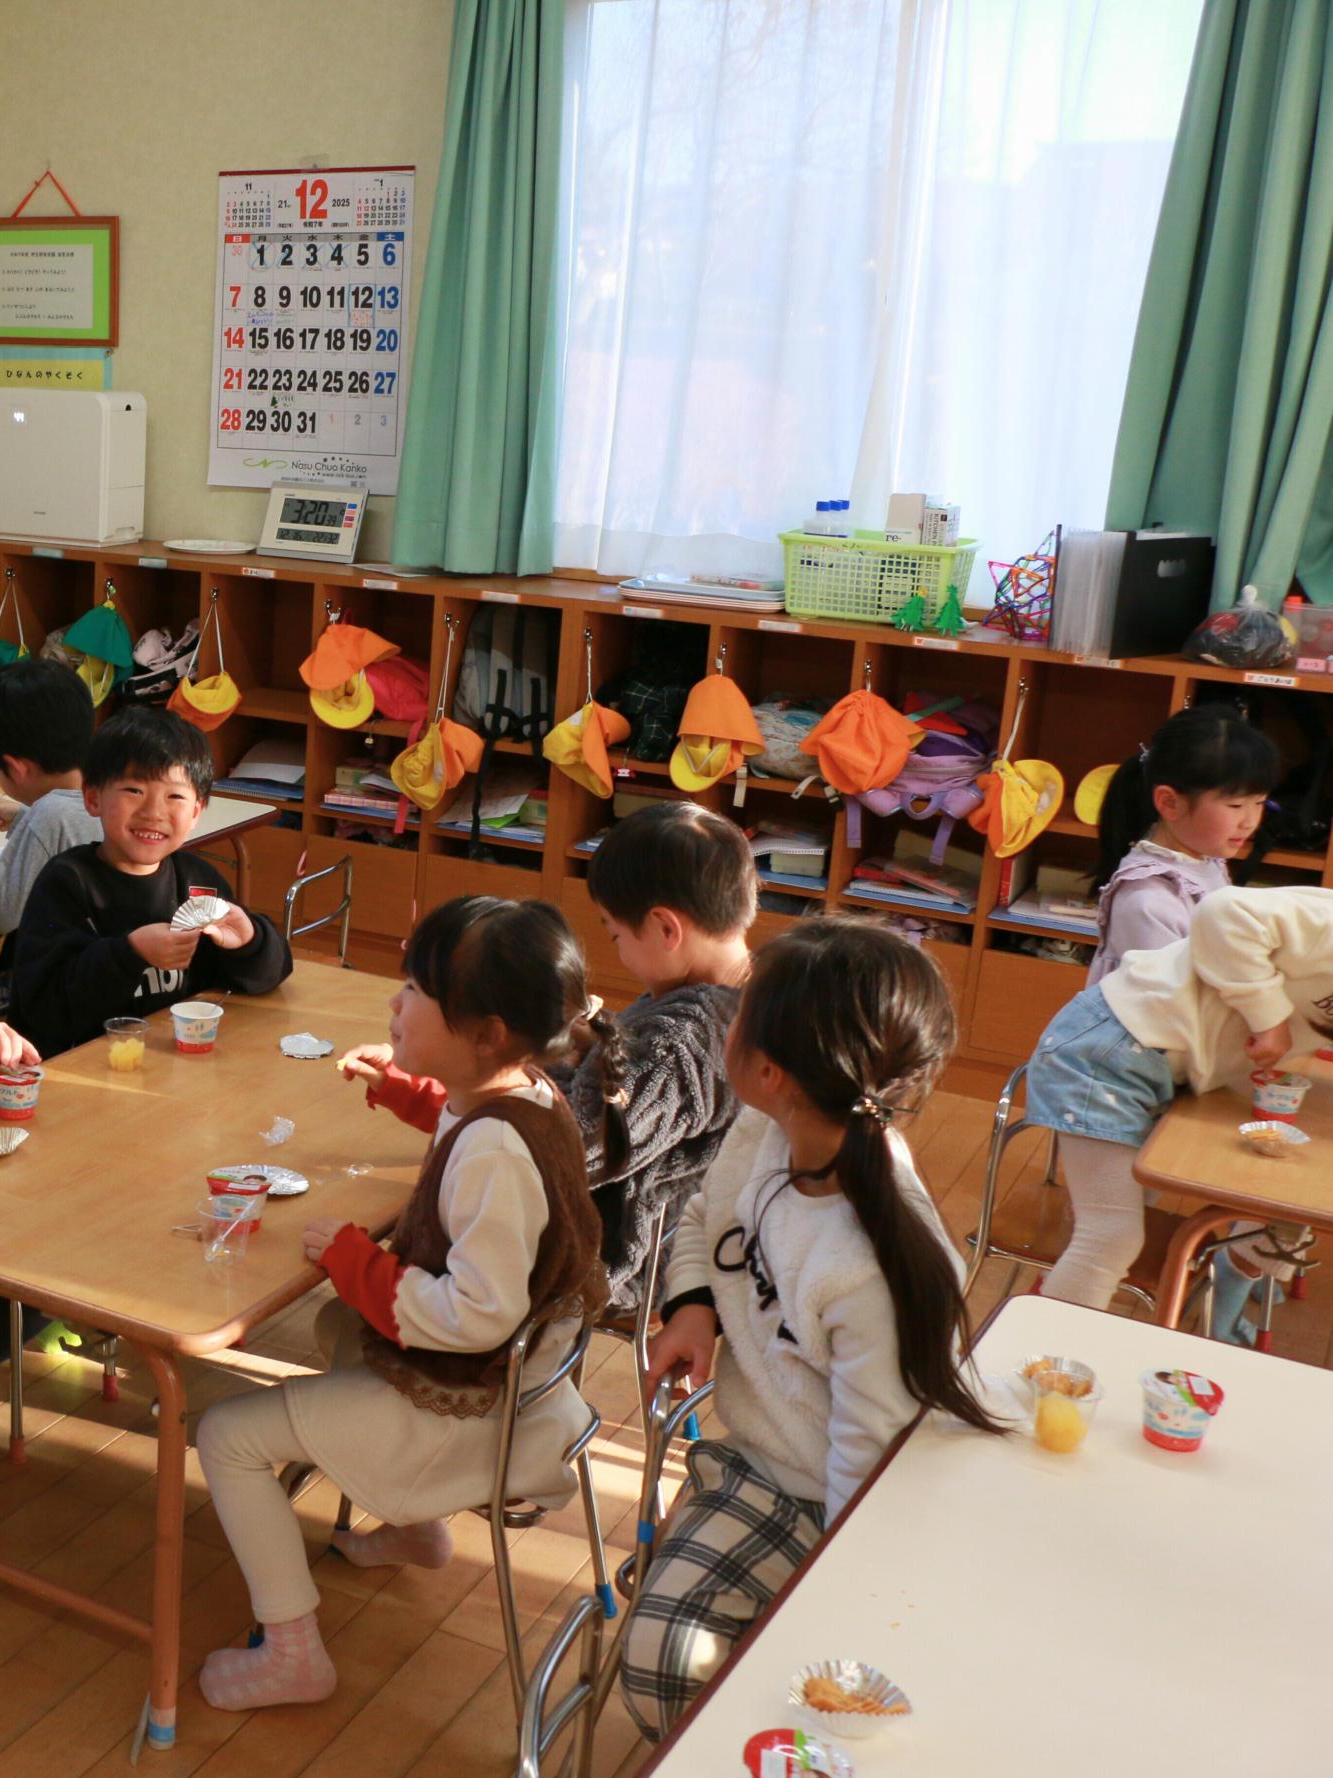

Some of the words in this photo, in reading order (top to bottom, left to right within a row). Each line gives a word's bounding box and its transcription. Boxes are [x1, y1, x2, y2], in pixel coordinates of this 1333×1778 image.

[245, 182, 252, 190] 11
[278, 200, 286, 208] 21
[295, 178, 328, 219] 12
[332, 198, 350, 207] 2025
[231, 245, 242, 256] 30
[257, 245, 264, 266] 1
[281, 244, 293, 266] 2
[306, 244, 318, 266] 3
[331, 244, 343, 266] 4
[356, 244, 368, 266] 5
[383, 243, 396, 266] 6
[230, 286, 241, 308] 7
[254, 286, 266, 308] 8
[279, 286, 291, 308] 9
[300, 286, 321, 308] 10
[327, 286, 345, 308] 11
[352, 286, 373, 308] 12
[378, 286, 399, 309] 13
[224, 327, 244, 349] 14
[249, 328, 269, 349] 15
[274, 328, 294, 350] 16
[299, 328, 320, 350] 17
[324, 329, 345, 351] 18
[350, 329, 371, 351] 19
[376, 329, 398, 352] 20
[6, 370, 82, 380] ひなんのやくそく
[223, 368, 242, 390] 21
[247, 369, 268, 390] 22
[272, 369, 292, 391] 23
[297, 370, 318, 392] 24
[322, 370, 343, 392] 25
[348, 371, 369, 394] 26
[374, 372, 396, 394] 27
[220, 409, 241, 430] 28
[245, 410, 266, 431] 29
[270, 410, 291, 432] 30
[297, 412, 316, 433] 31
[329, 413, 334, 424] 1
[354, 414, 361, 425] 2
[380, 415, 387, 426] 3
[292, 460, 312, 470] Nasu
[315, 462, 338, 472] Chuo
[340, 464, 367, 473] Kanko
